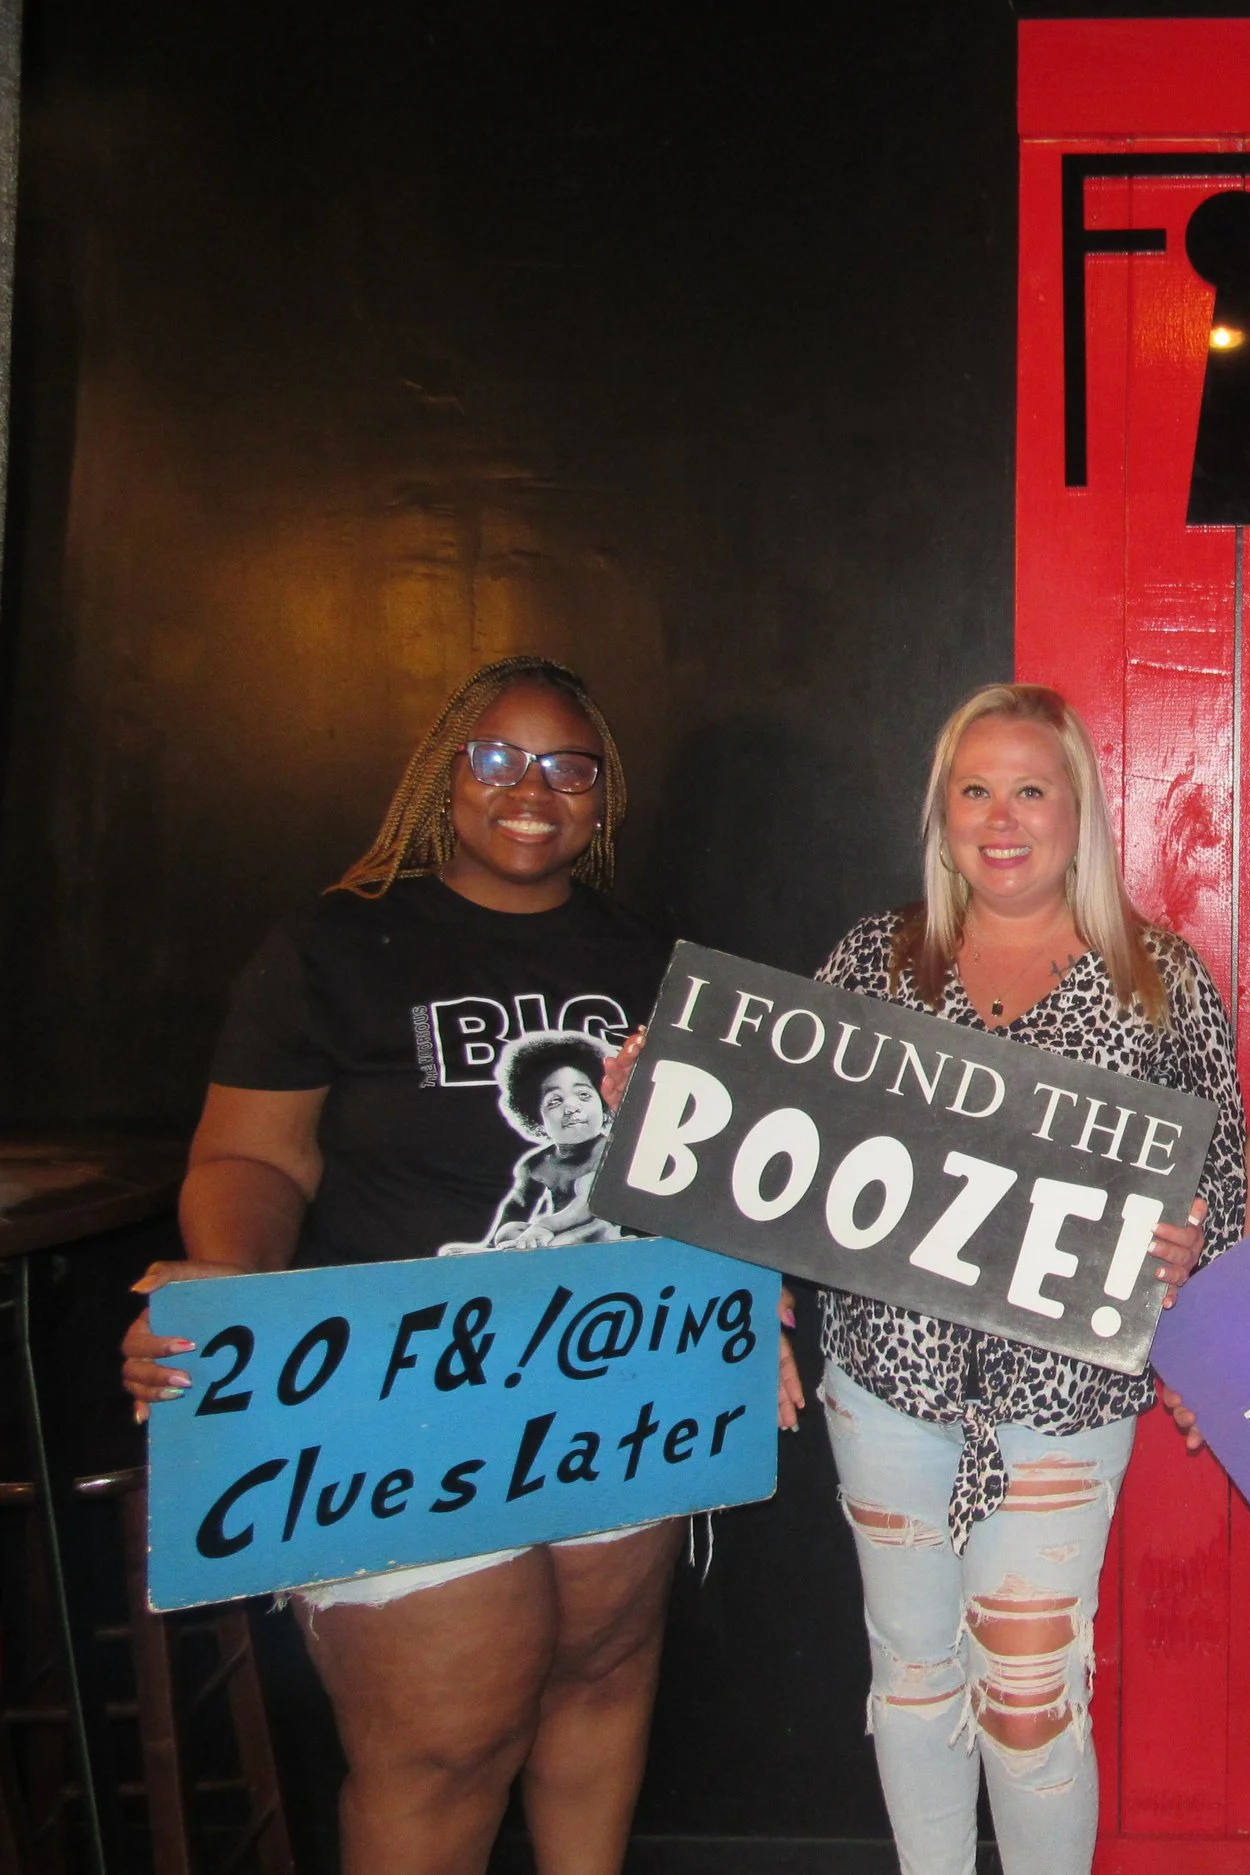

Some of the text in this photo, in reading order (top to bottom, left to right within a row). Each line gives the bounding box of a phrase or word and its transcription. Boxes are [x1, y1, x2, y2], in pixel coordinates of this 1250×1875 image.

[671, 976, 1184, 1176] I FOUND THE
[626, 1059, 1165, 1338] BOOZE!
[194, 1315, 351, 1417] 20
